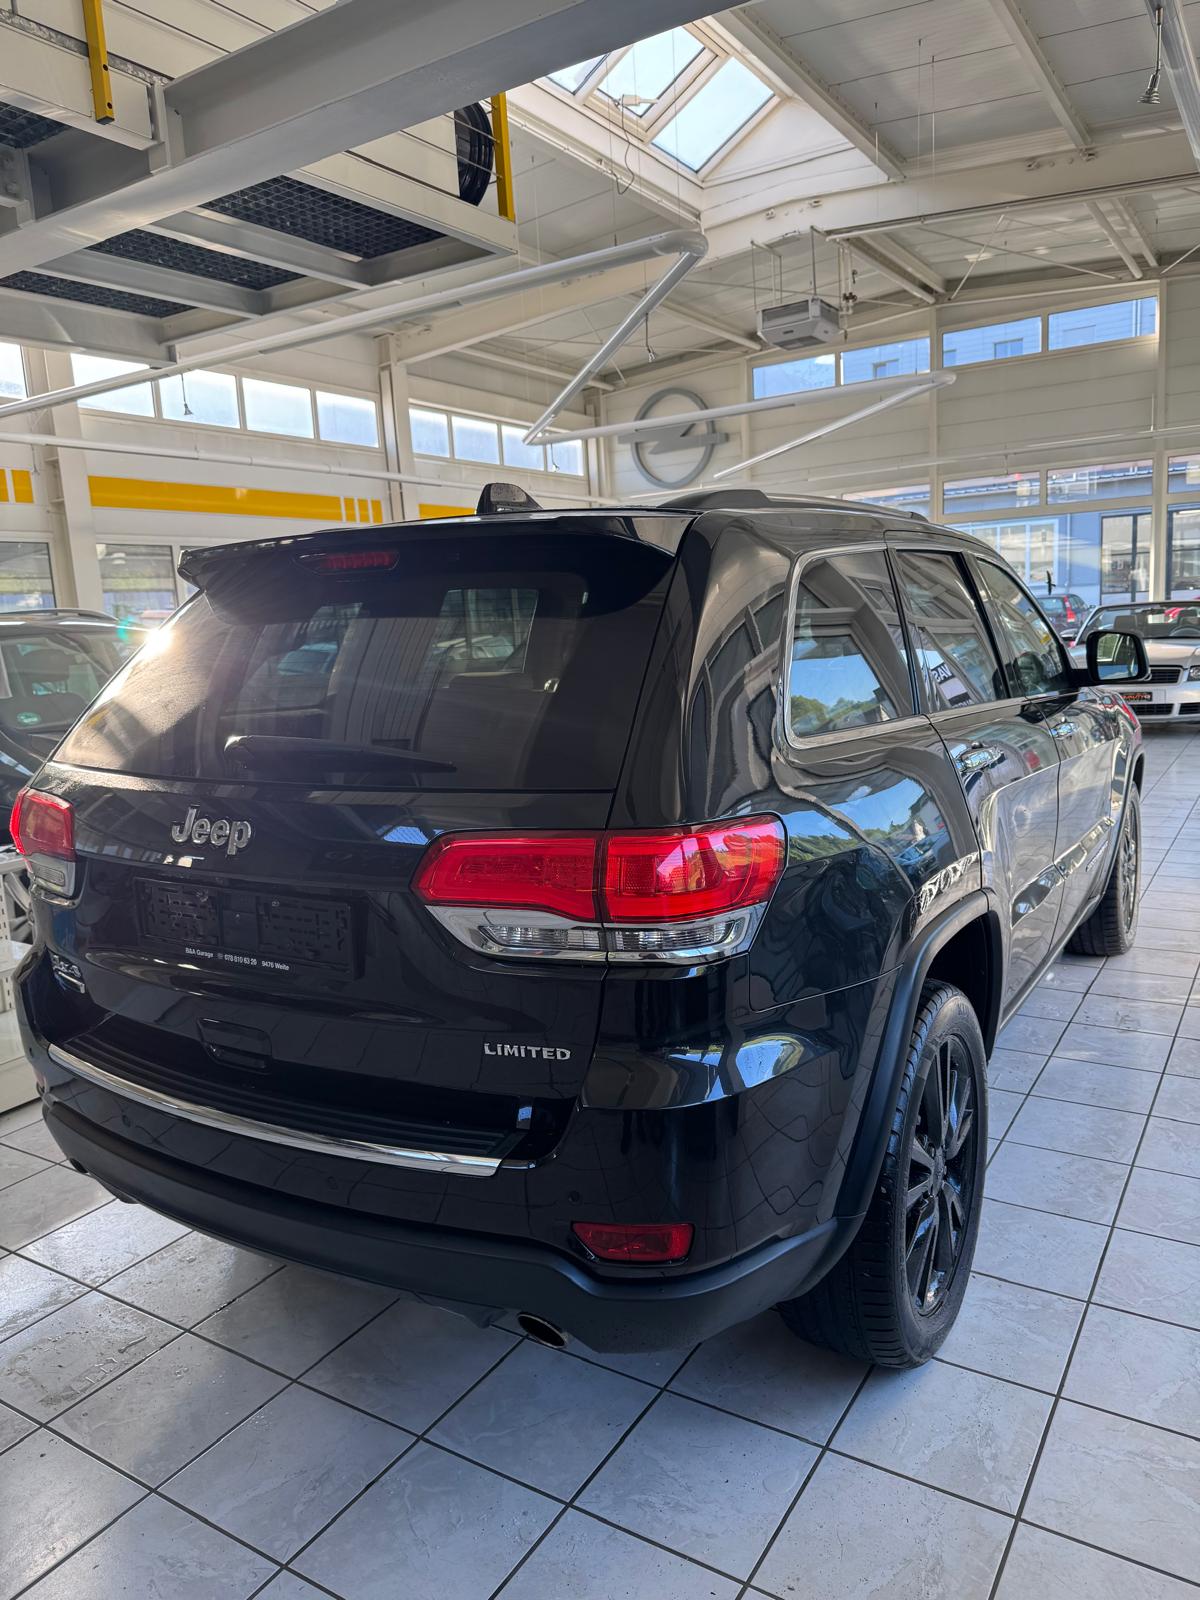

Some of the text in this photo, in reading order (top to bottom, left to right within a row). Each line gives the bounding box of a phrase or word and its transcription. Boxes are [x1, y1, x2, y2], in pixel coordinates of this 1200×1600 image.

[172, 807, 252, 855] Jeep
[196, 949, 213, 958] Garage
[483, 1042, 571, 1061] LIMITED
